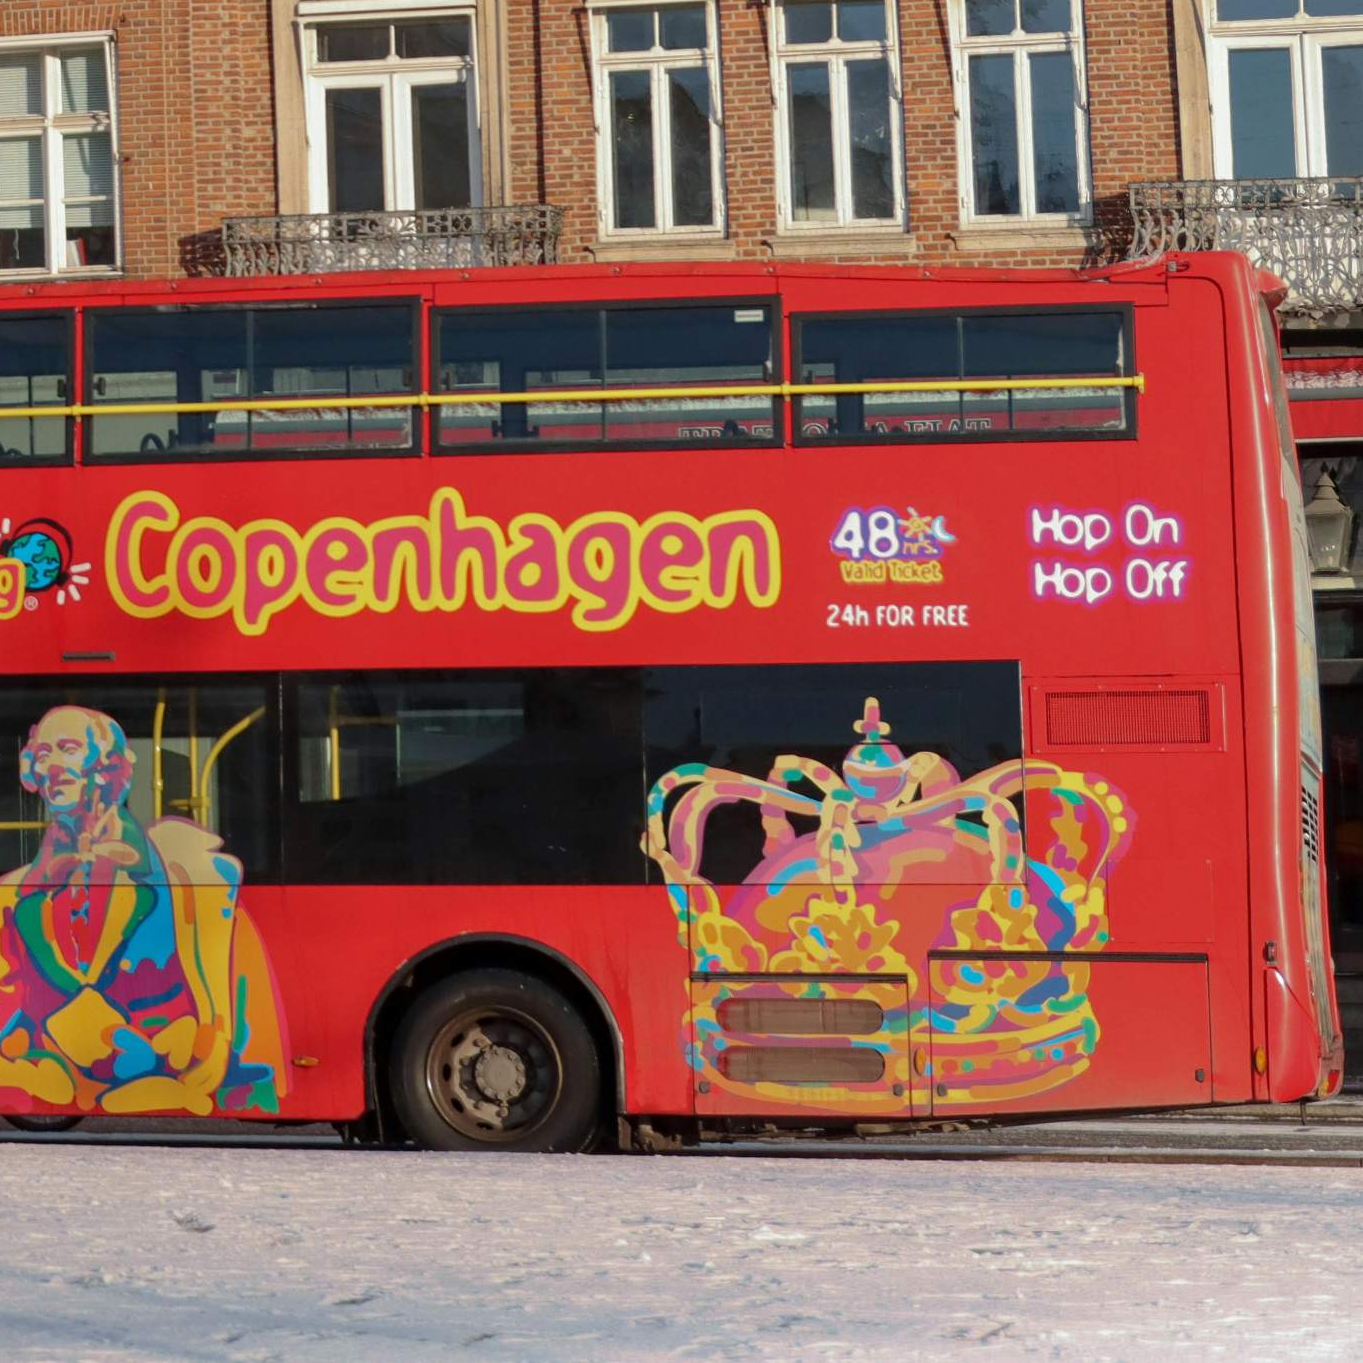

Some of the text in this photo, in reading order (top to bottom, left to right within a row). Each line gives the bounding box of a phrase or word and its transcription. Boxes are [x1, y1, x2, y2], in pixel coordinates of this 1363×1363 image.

[833, 511, 899, 558] 48
[1030, 503, 1180, 552] Hop On
[104, 484, 781, 636] Copenhagen
[840, 559, 944, 583] Valid Ticket
[1033, 558, 1189, 605] Hop Off
[826, 604, 969, 628] 24h FOR FREE
